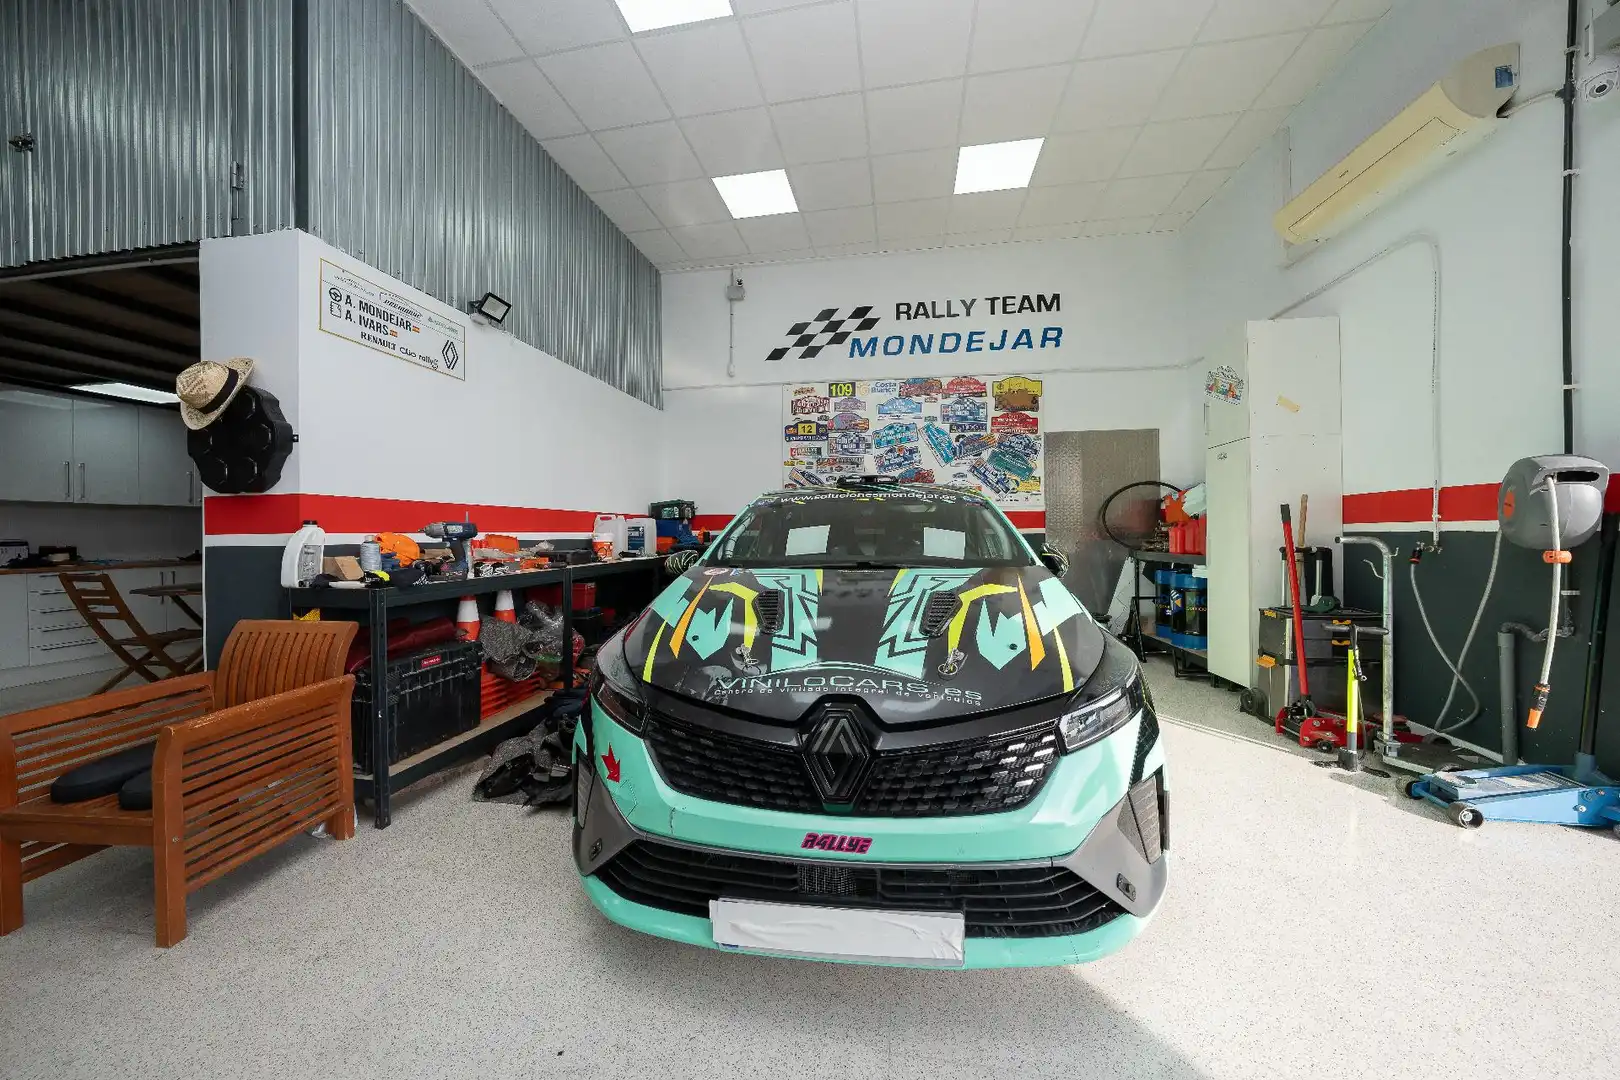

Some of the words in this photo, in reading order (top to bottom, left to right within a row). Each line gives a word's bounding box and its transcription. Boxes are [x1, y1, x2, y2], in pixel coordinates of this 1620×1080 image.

[358, 299, 412, 332] MONDEJAR
[895, 298, 977, 321] RALLY
[984, 293, 1061, 316] TEAM
[358, 314, 389, 336] IVARS
[360, 331, 397, 351] RENAULT
[848, 326, 1063, 359] MONDEJAR
[830, 384, 853, 397] 109
[801, 424, 813, 434] 12
